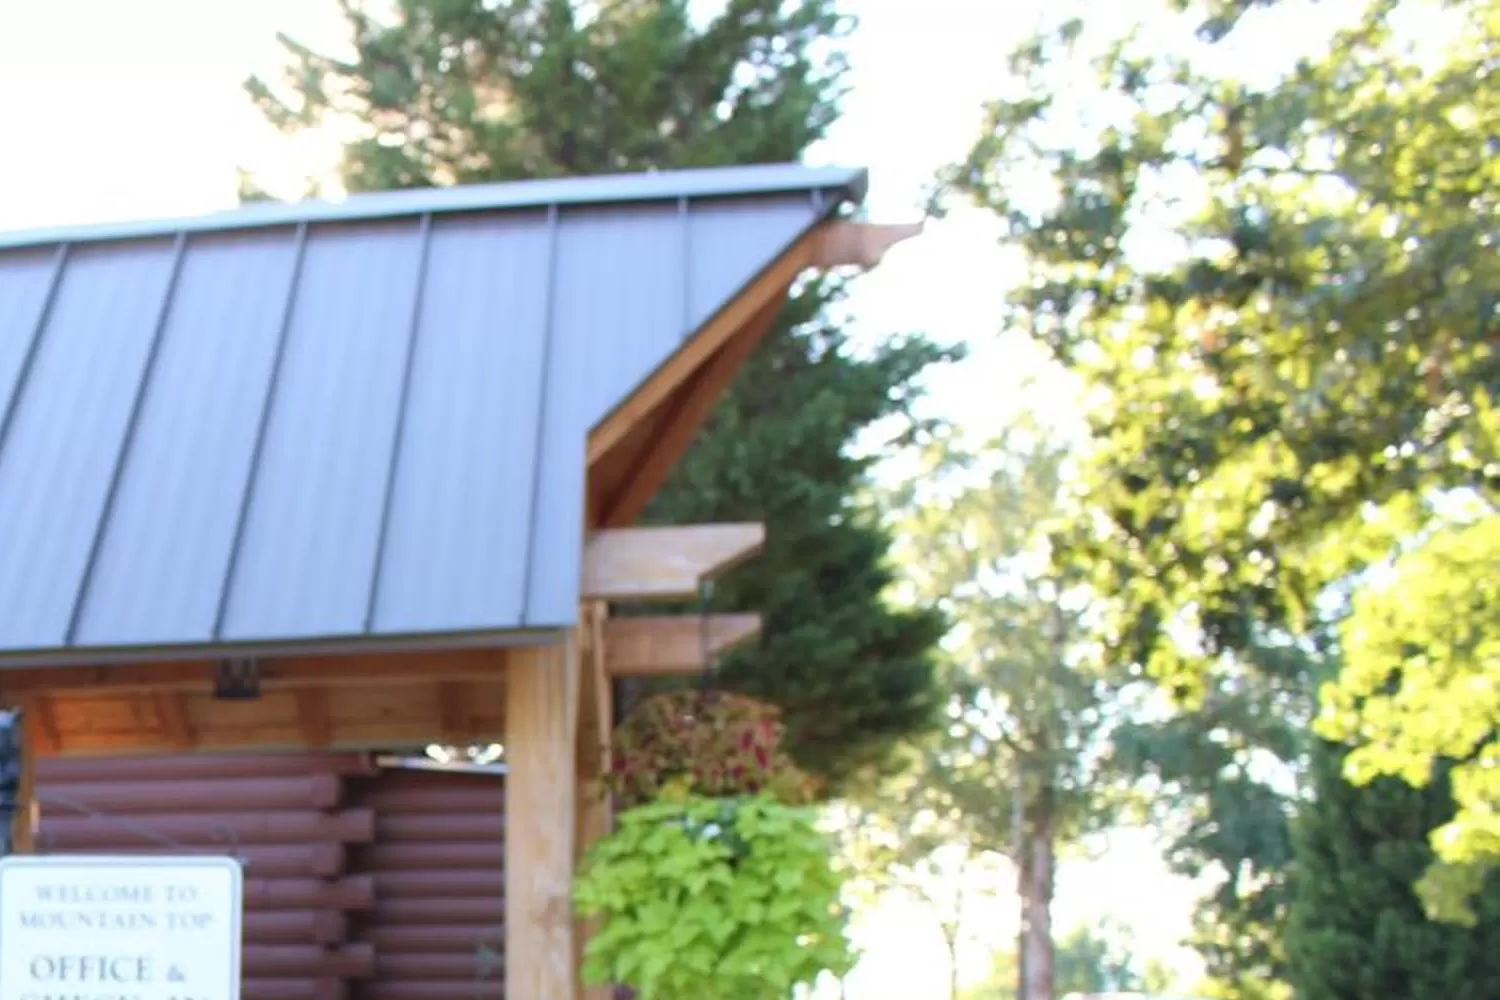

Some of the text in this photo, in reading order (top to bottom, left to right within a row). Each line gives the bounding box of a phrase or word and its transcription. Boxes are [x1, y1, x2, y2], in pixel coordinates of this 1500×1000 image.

[35, 884, 198, 904] WELCOME TO
[19, 911, 214, 929] MOUNTAIN TOP
[29, 955, 186, 983] OFFICE &
